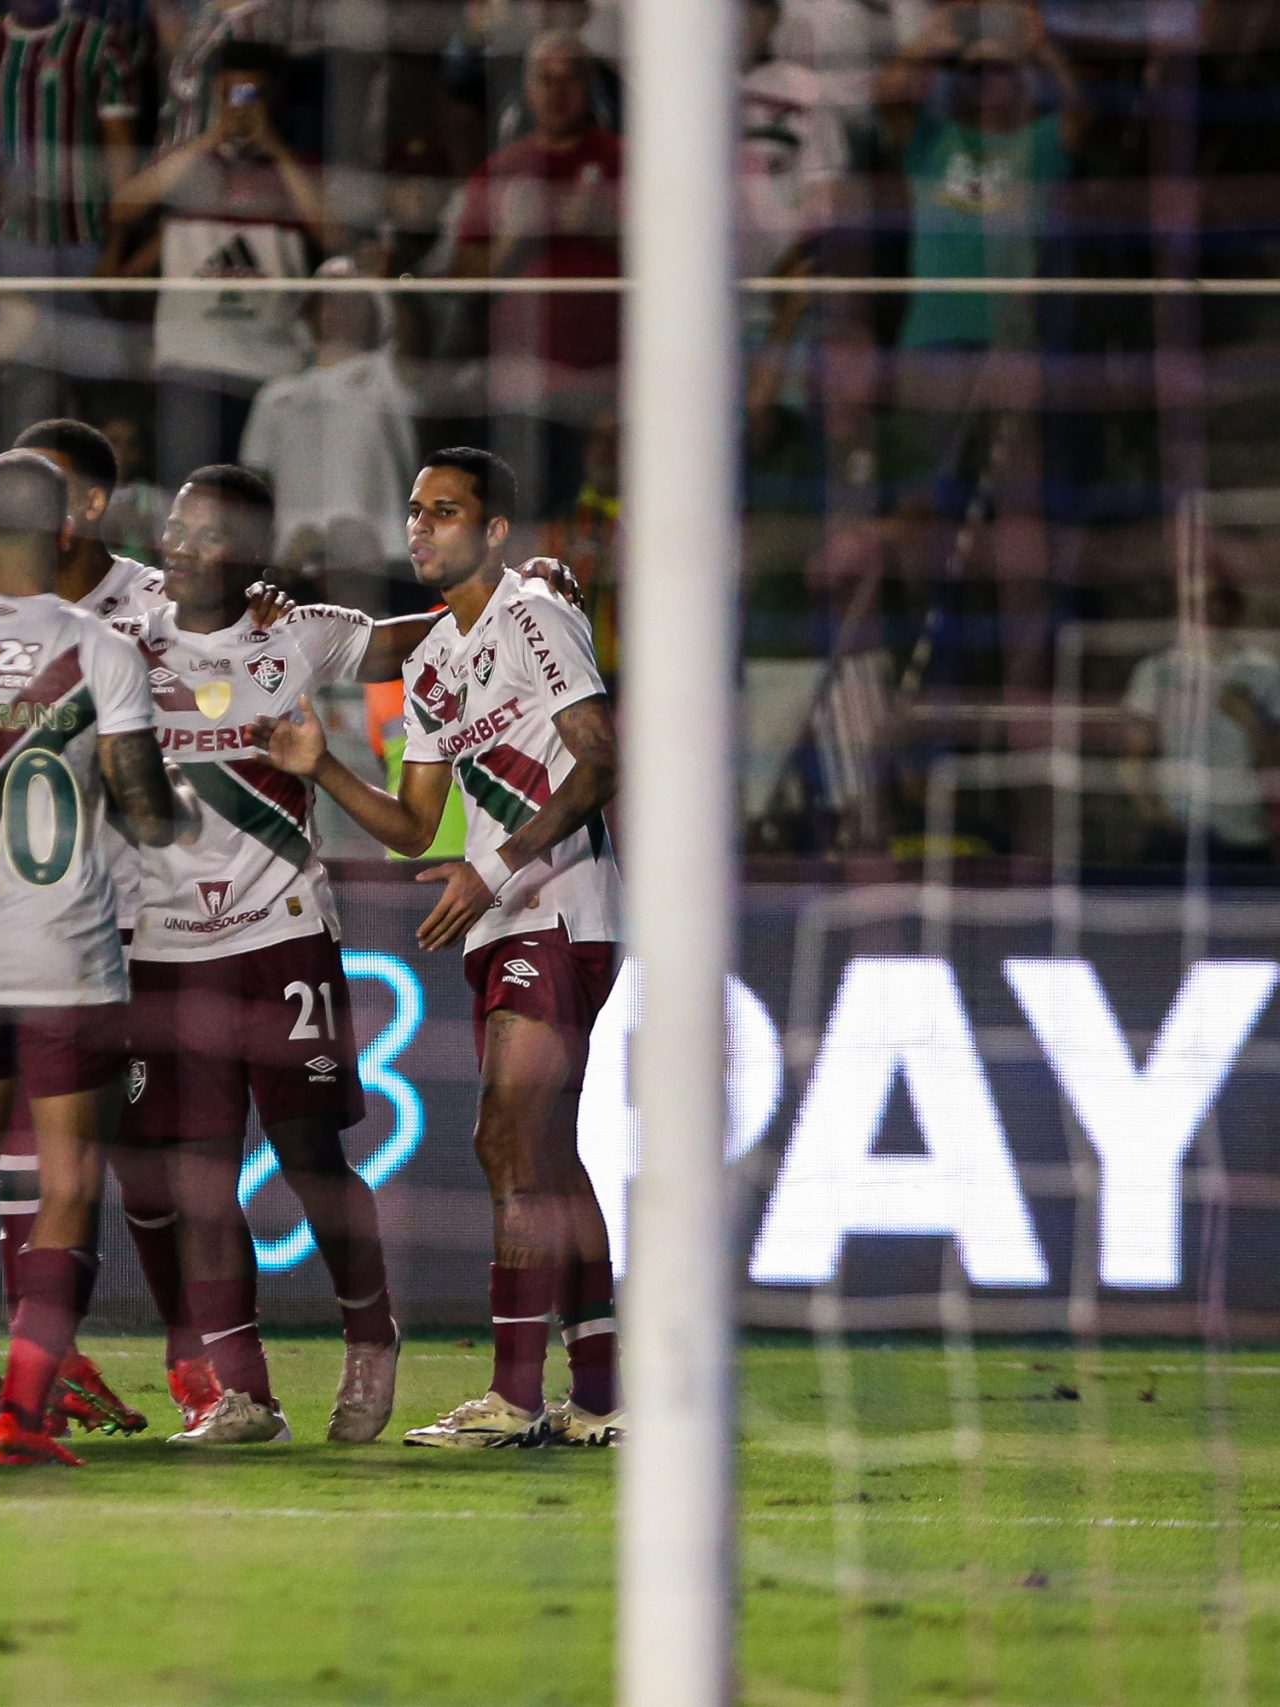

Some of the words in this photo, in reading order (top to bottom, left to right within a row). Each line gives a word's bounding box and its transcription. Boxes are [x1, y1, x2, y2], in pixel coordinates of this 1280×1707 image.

[507, 600, 568, 697] ZINZANE
[283, 980, 336, 1041] 21
[578, 953, 1280, 1290] PAY
